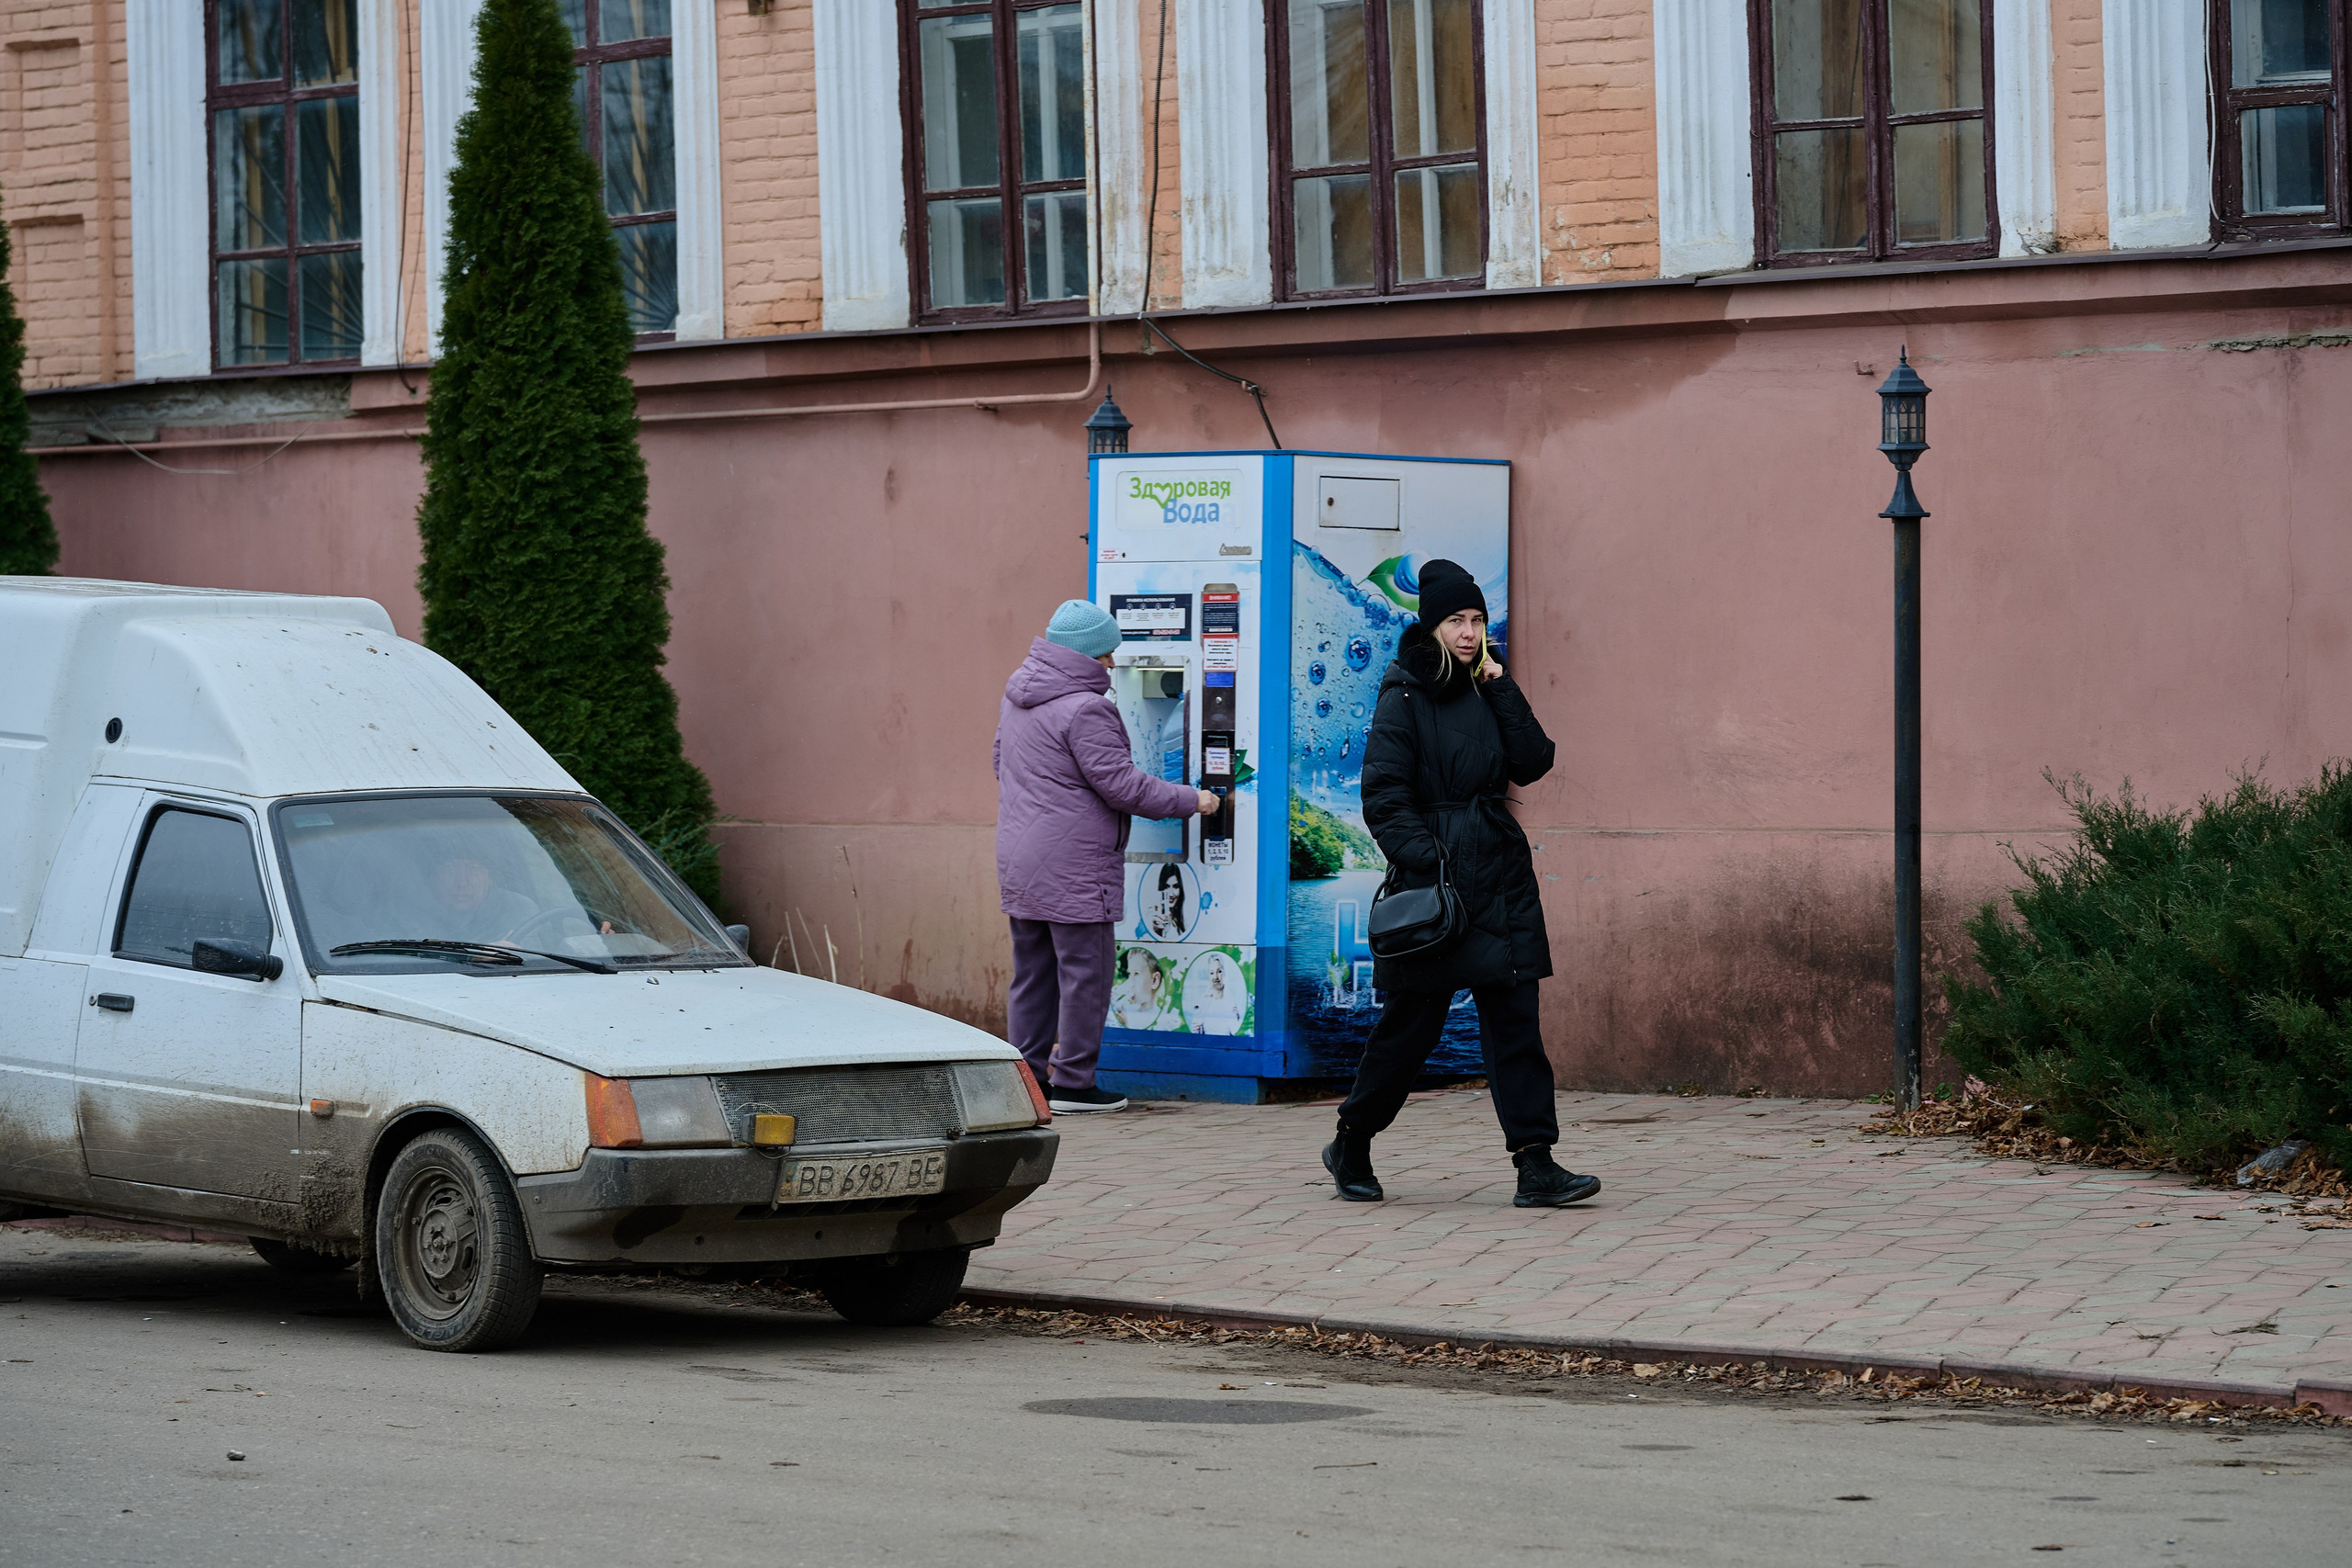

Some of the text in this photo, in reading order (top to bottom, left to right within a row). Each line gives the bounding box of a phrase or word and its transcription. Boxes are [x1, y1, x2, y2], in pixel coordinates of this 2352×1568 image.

[1163, 499, 1220, 524] Вода
[842, 1161, 899, 1193] 6987
[905, 1156, 941, 1190] BE
